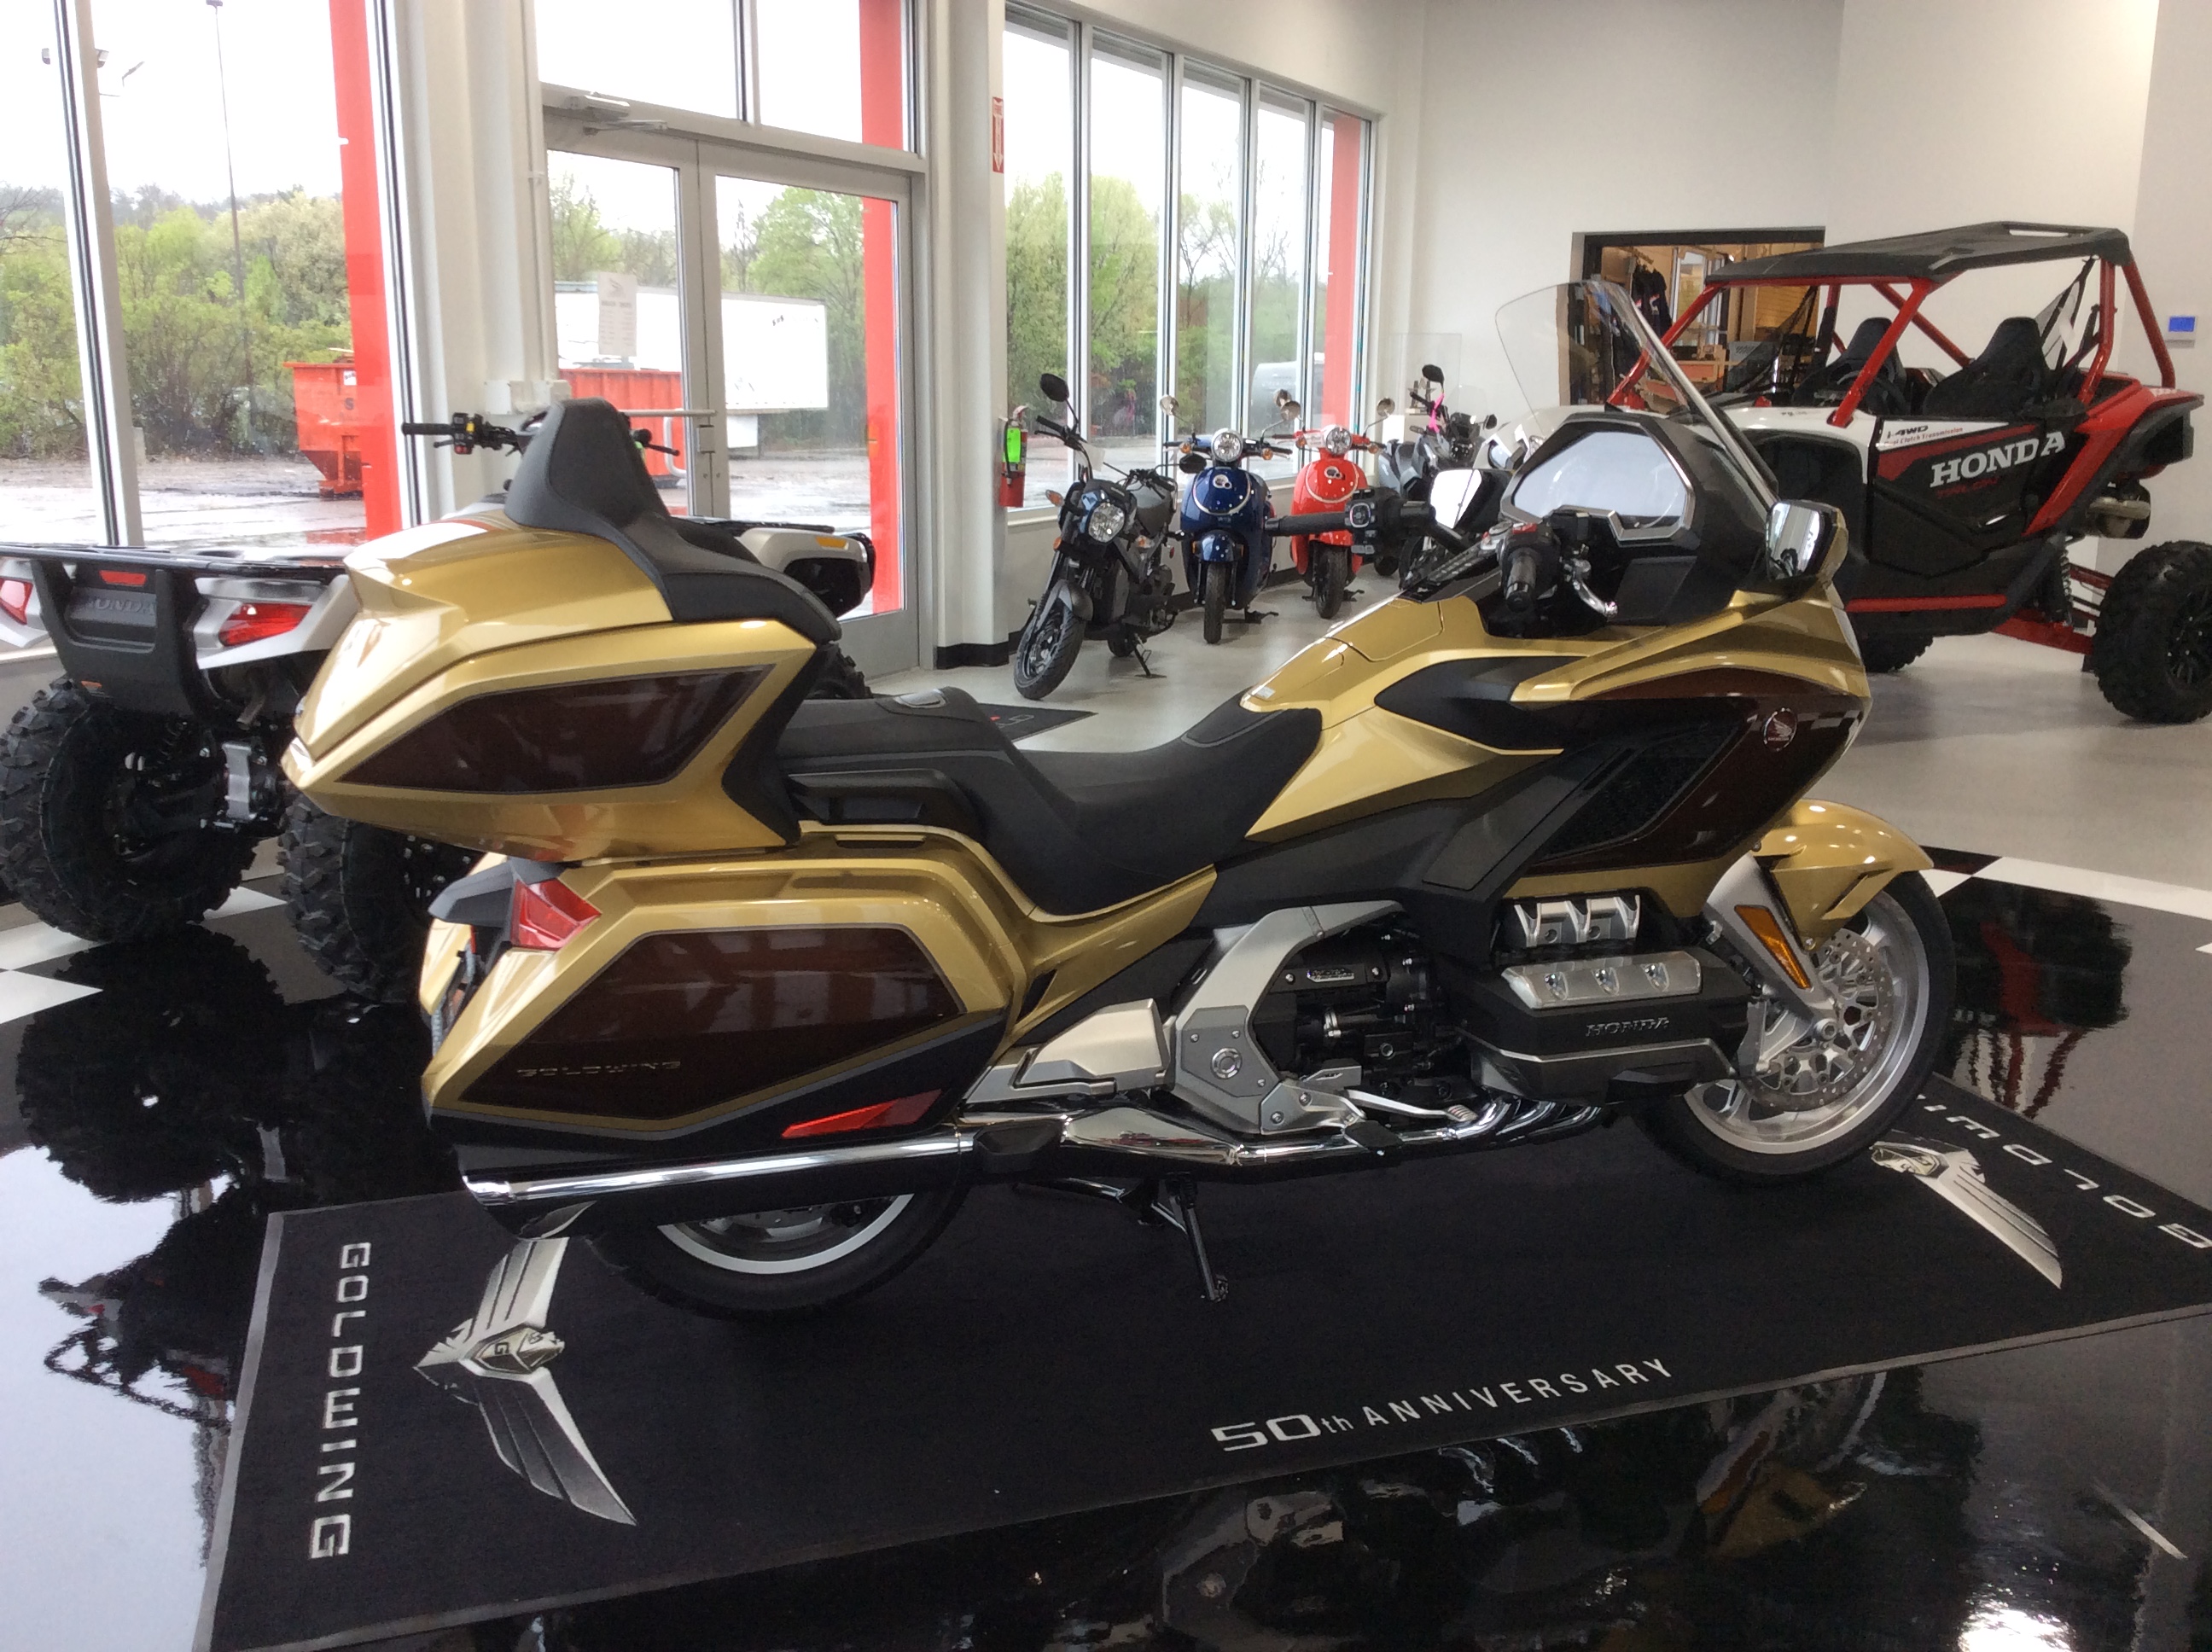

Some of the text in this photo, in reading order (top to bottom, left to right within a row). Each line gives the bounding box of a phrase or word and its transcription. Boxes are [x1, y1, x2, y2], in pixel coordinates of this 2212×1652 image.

[1930, 431, 2066, 488] HONDA
[82, 596, 157, 615] ONDA
[1586, 1016, 1670, 1037] HONDA
[310, 1242, 372, 1560] GOLDWING
[1210, 1358, 1673, 1452] 50th ANNIVERSARY
